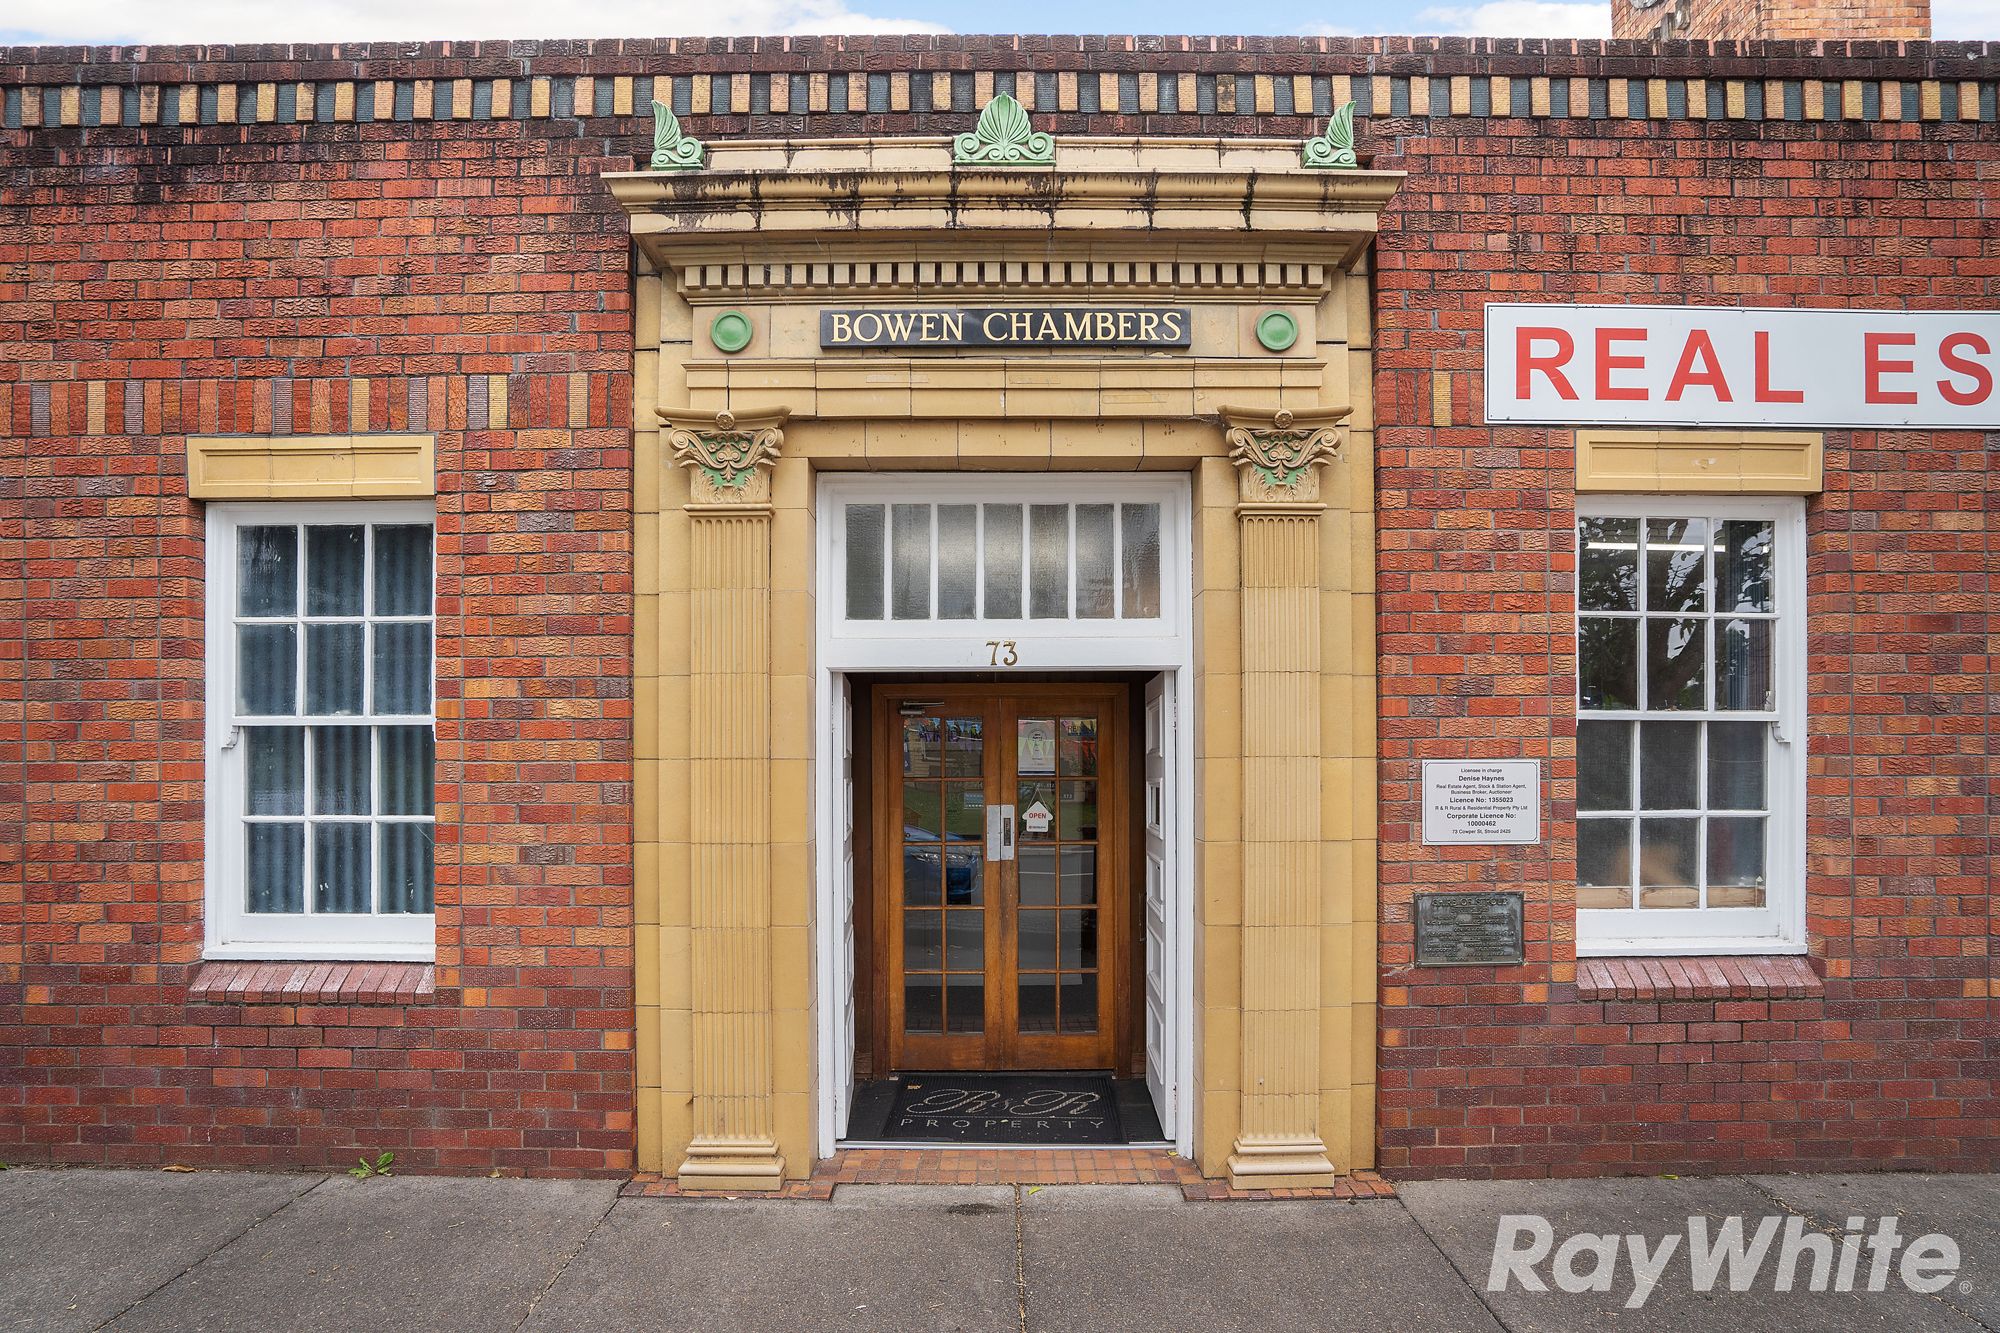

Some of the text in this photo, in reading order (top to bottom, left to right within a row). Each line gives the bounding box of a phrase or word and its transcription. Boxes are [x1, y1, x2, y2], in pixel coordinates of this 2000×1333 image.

[831, 311, 1182, 342] BOWEN CHAMBERS
[1515, 326, 1805, 404] REAL
[985, 640, 1018, 666] 73
[900, 1118, 1105, 1130] PROPERTY
